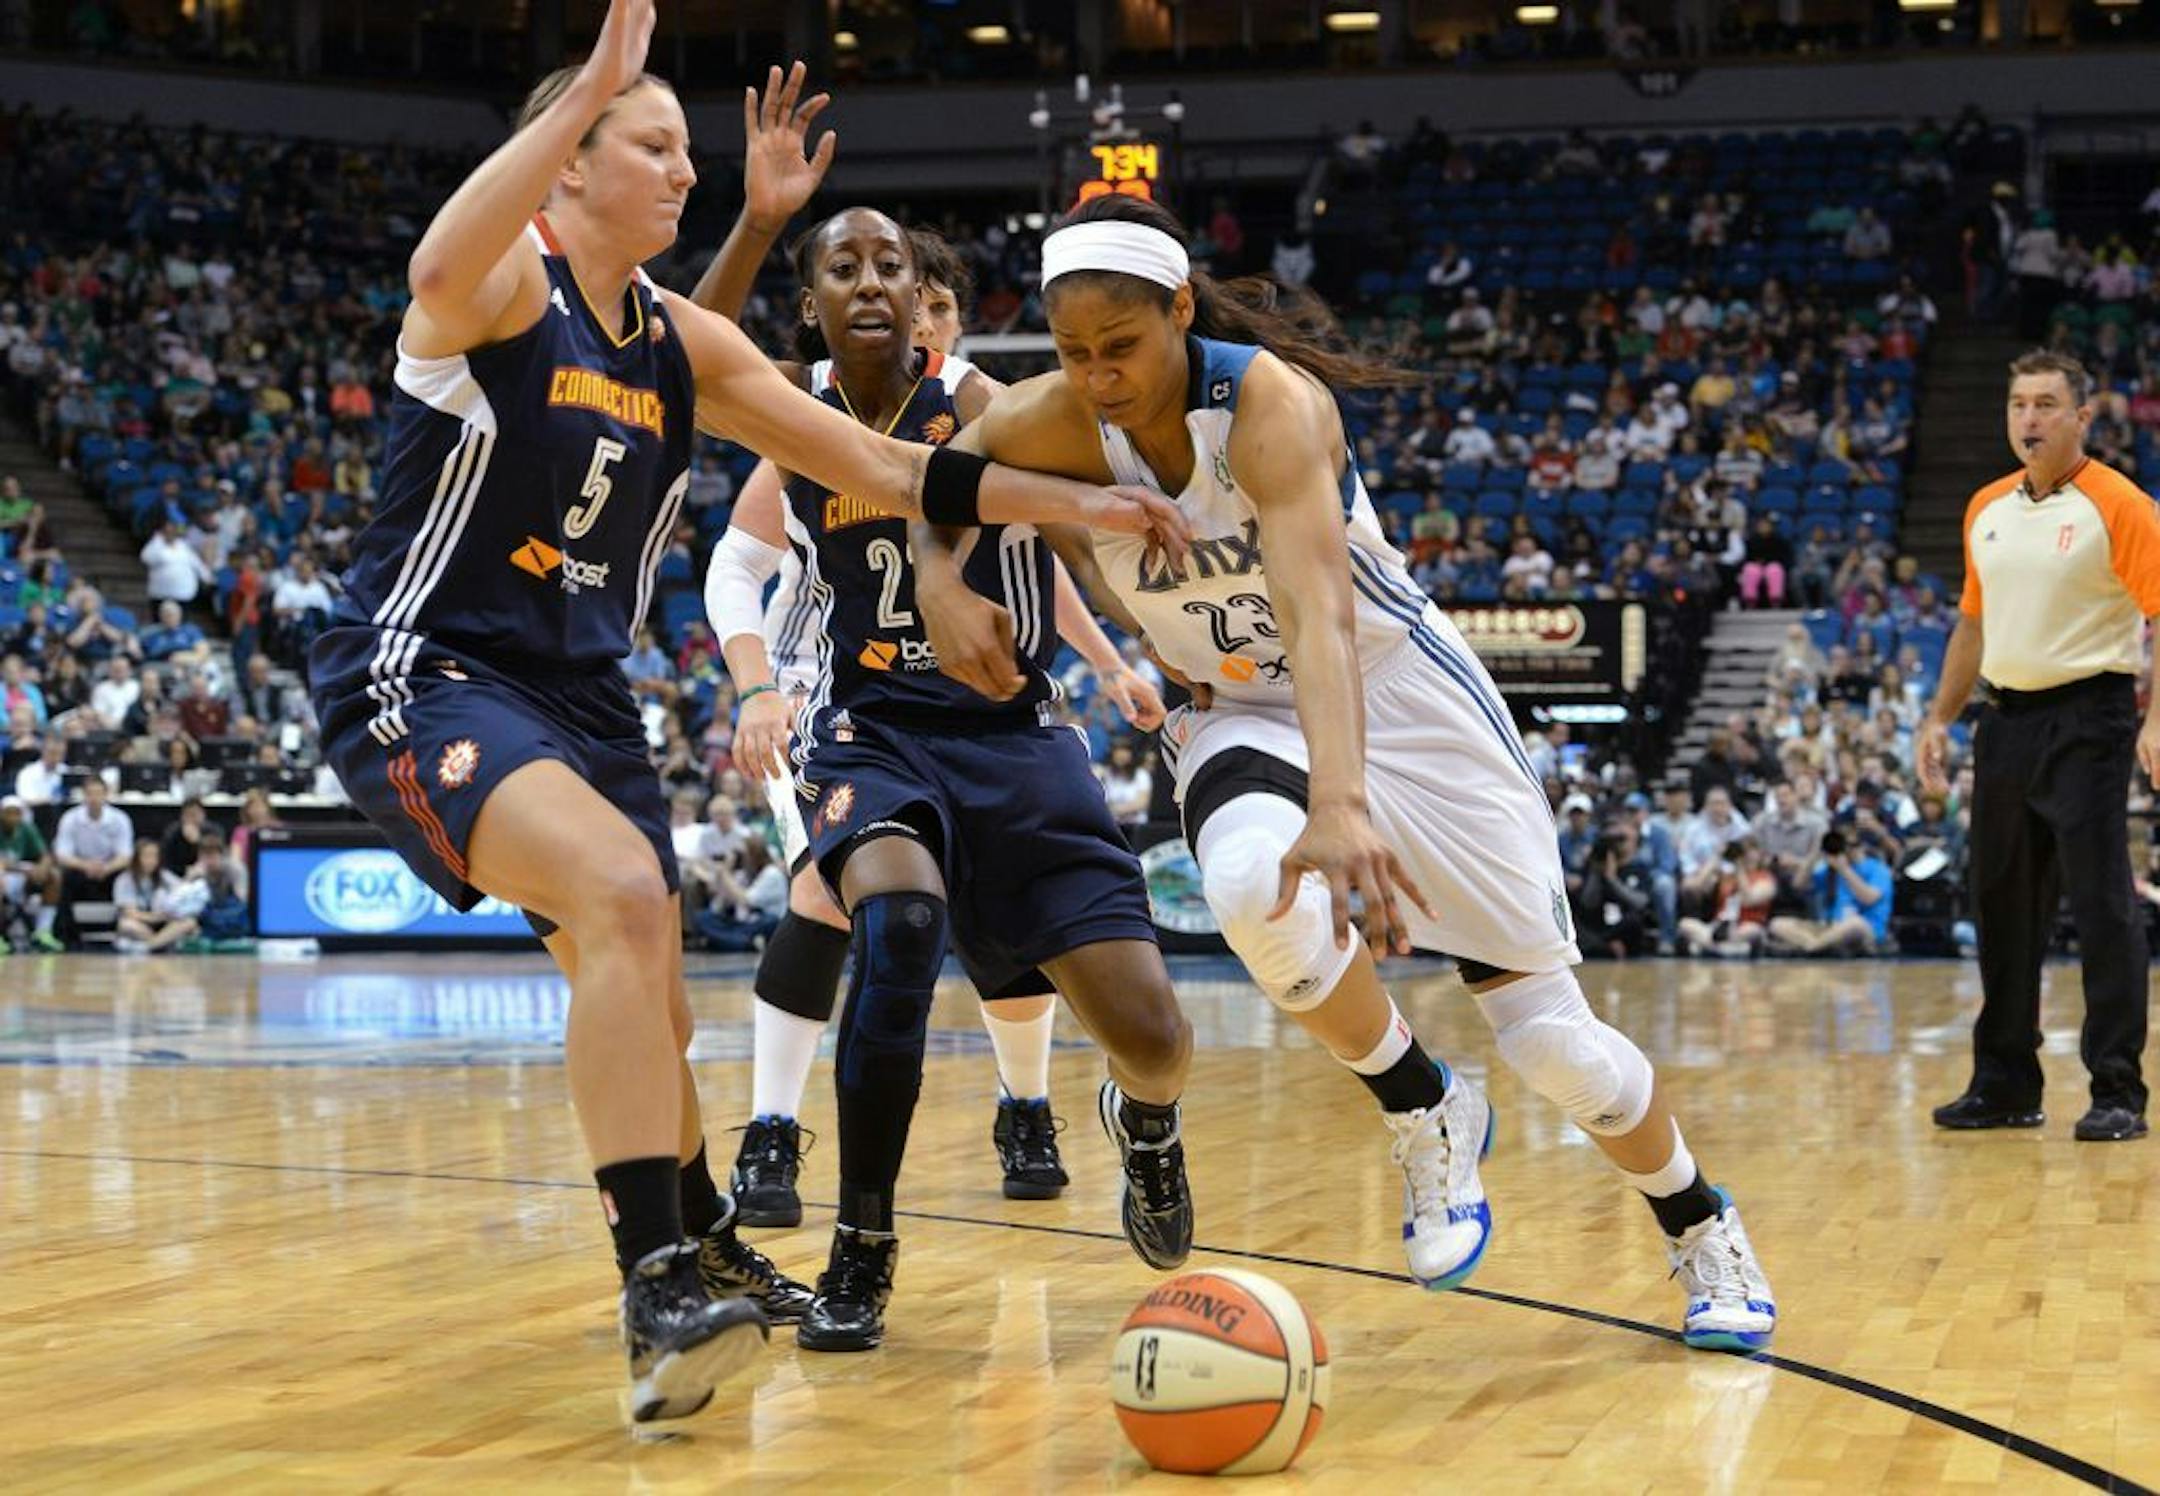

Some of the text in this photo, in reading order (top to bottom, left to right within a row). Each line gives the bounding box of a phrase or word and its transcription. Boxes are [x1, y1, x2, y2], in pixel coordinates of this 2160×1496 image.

[563, 436, 626, 540] 5
[866, 538, 915, 628] 2
[1183, 593, 1280, 653] 23
[335, 870, 401, 898] FOX
